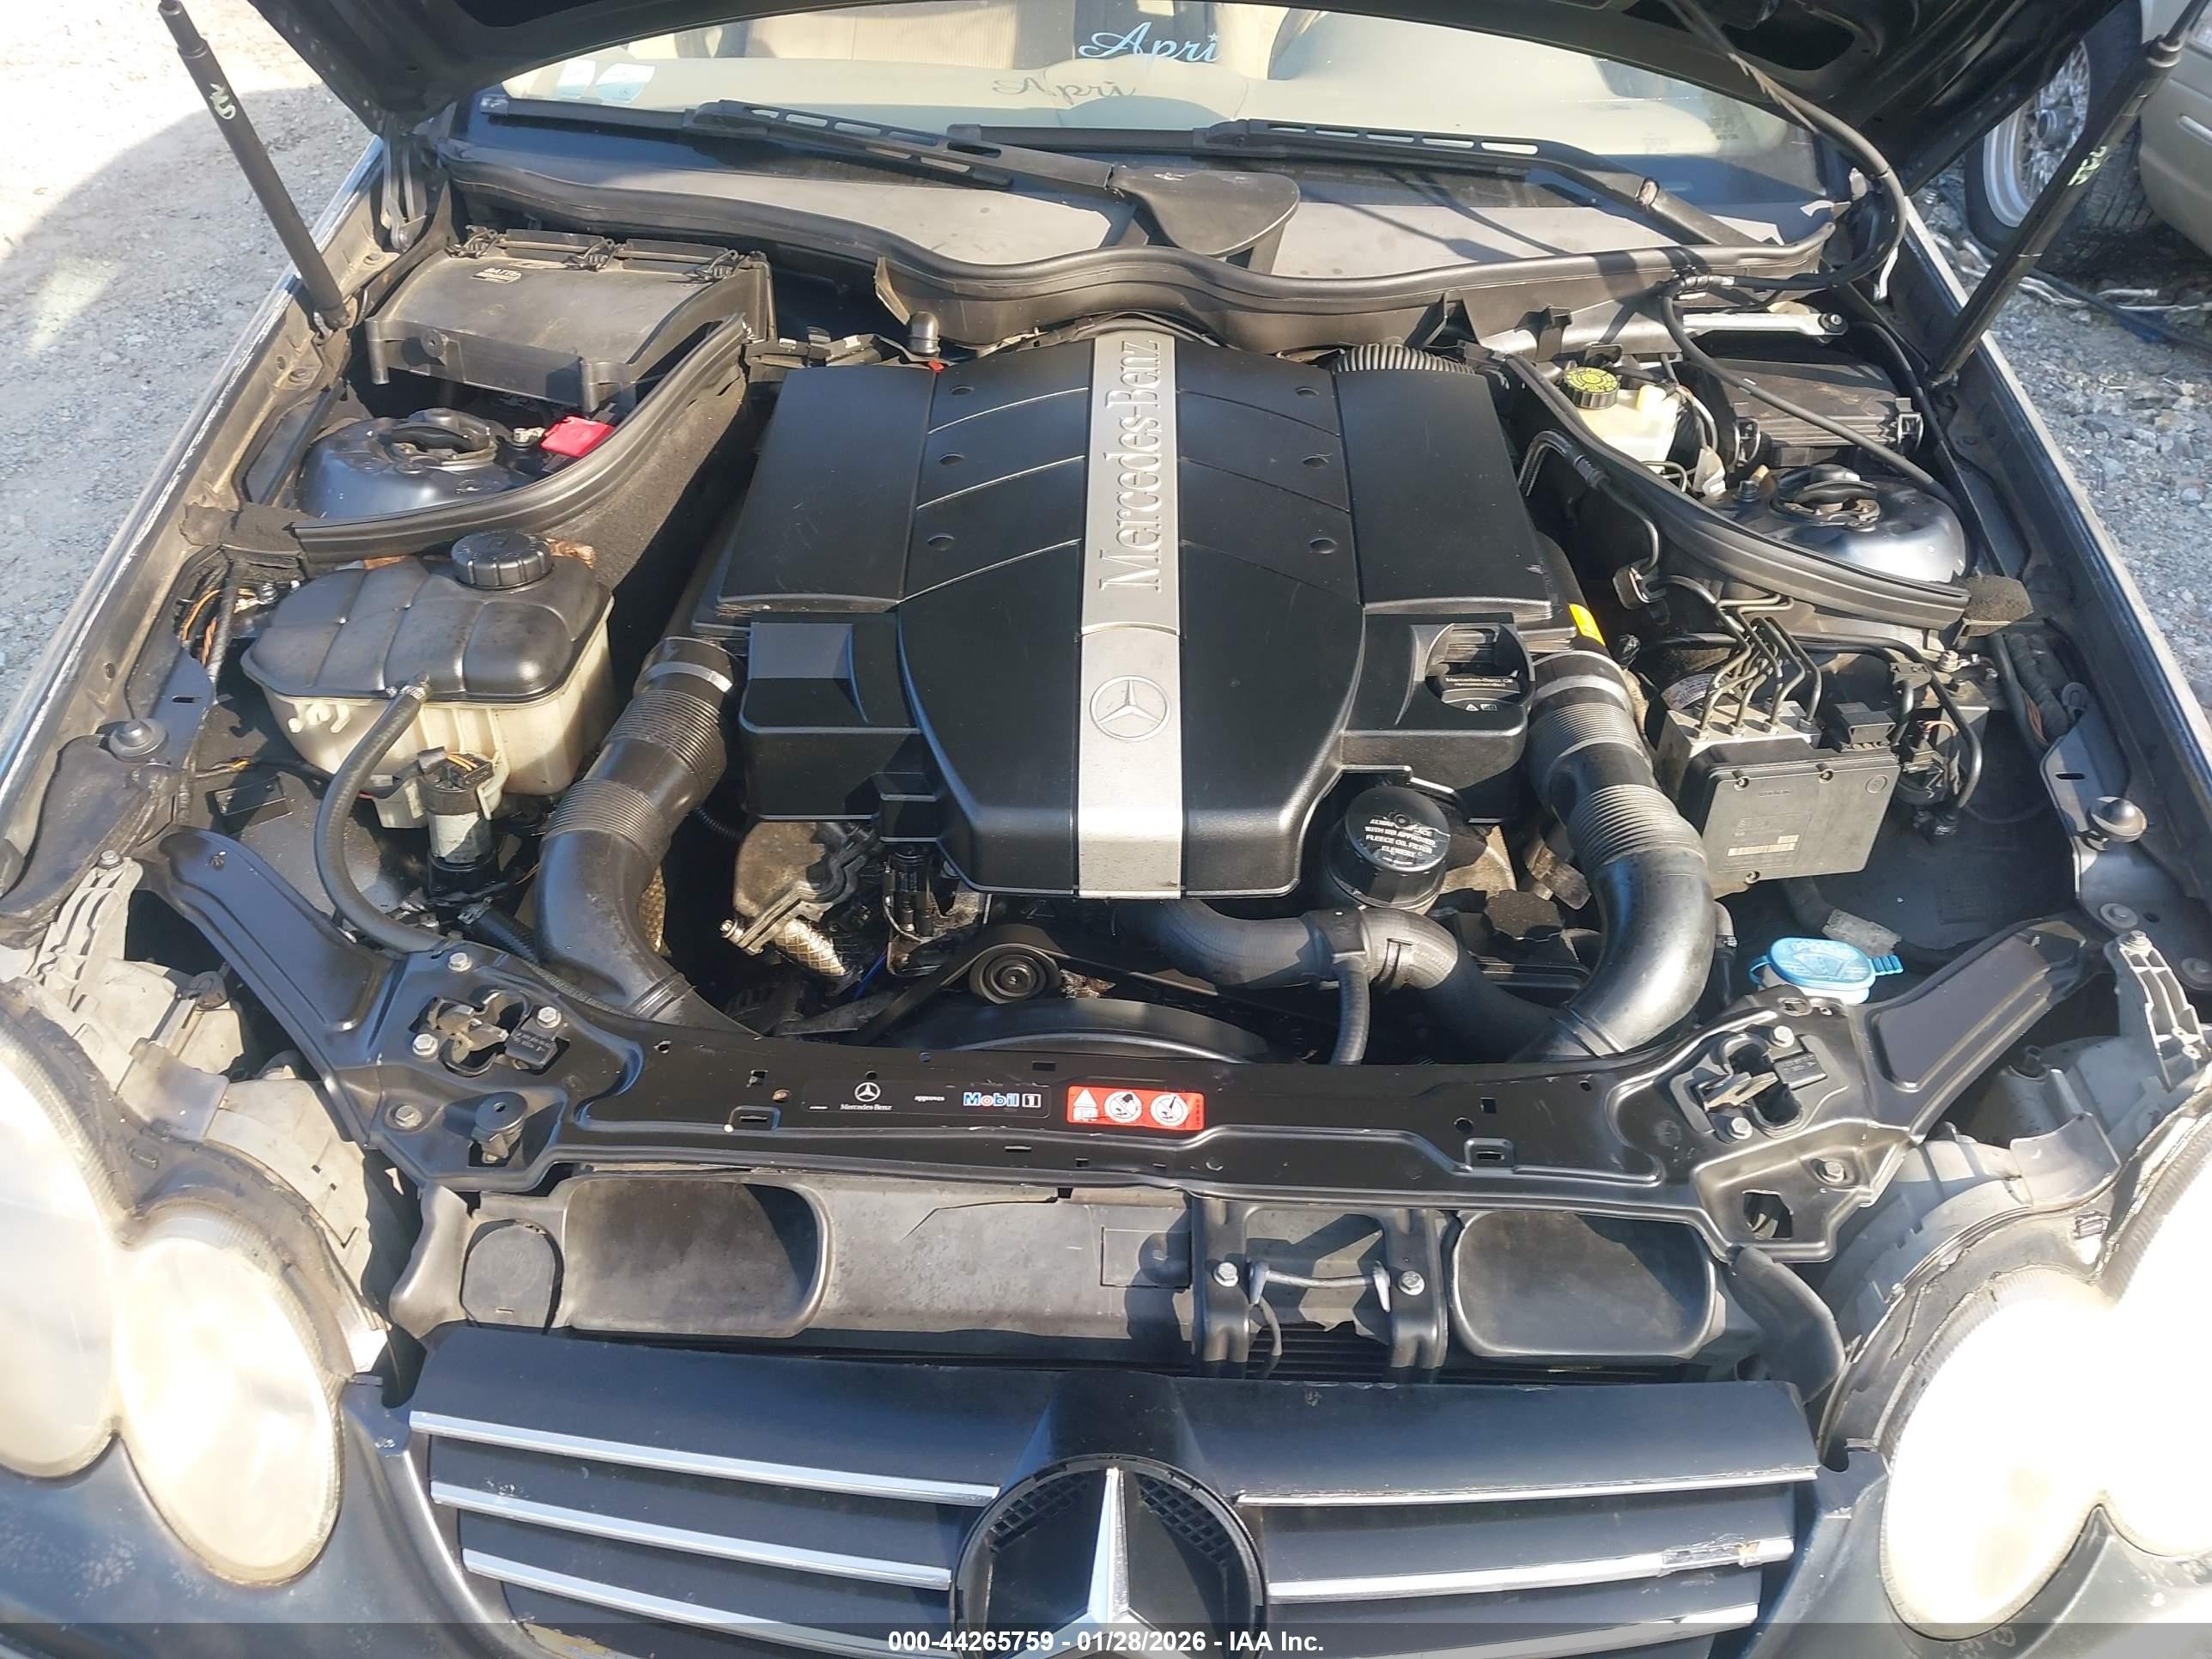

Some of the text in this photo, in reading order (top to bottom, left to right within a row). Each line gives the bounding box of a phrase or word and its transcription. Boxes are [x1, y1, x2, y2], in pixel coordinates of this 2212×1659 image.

[1098, 339, 1162, 593] Mercedes-Benz
[1364, 825, 1384, 834] WITH
[1365, 834, 1395, 844] FLEECE
[1395, 839, 1408, 848] OIL
[1381, 845, 1416, 858] ELEMENT
[963, 1091, 1019, 1107] Mobil
